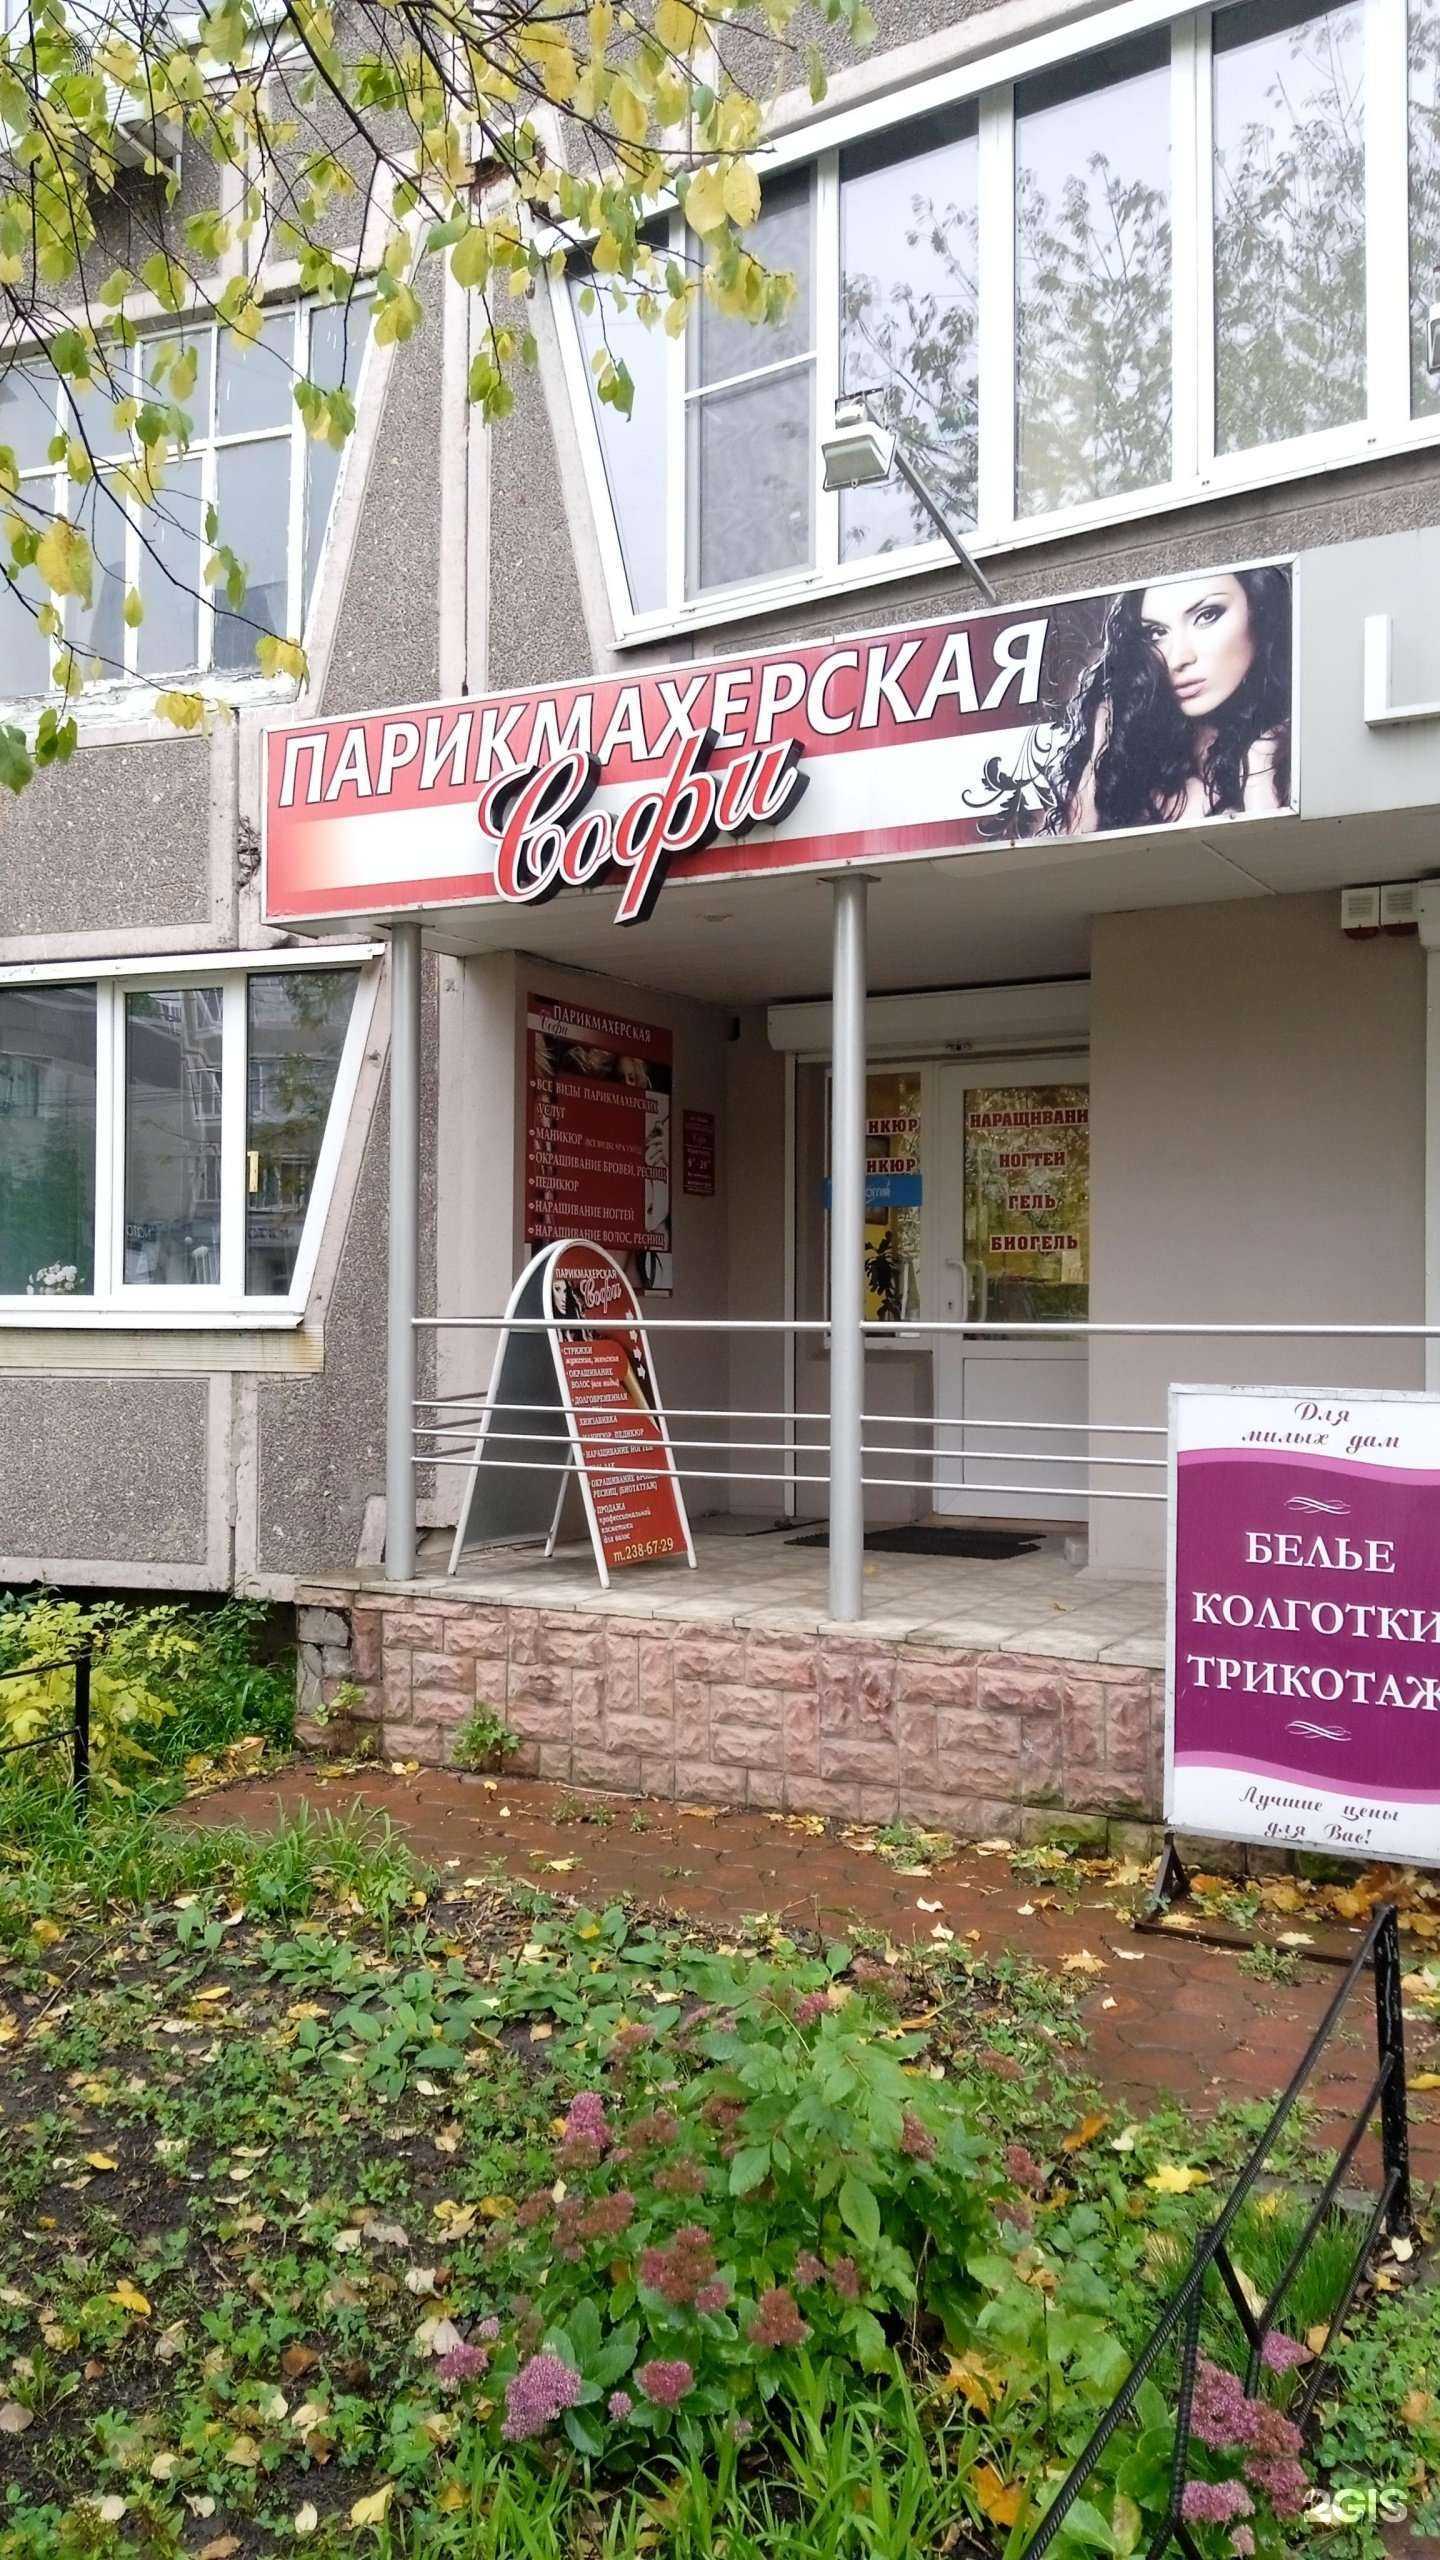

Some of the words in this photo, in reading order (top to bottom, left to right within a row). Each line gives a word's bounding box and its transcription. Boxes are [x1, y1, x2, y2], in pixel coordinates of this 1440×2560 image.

[278, 617, 1050, 809] ПАРИКМАХЕРСКАЯ
[477, 728, 806, 926] Софи
[553, 1004, 651, 1042] ПАРИКМАХЕРСКАЯ
[536, 1078, 553, 1093] ВСЕ
[866, 1117, 918, 1134] ИКЮР
[969, 1108, 1089, 1129] НАРАЩИВАНИ
[535, 1127, 583, 1145] МАНИКЮР
[535, 1152, 601, 1172] ОКРАШИВАНИЕ
[866, 1158, 917, 1173] ИКЮР
[535, 1176, 580, 1193] ПЕДИКЮР
[1008, 1194, 1057, 1211] ГЕЛЬ
[990, 1235, 1079, 1252] БИОГЕЛЬ
[555, 1268, 618, 1280] ПАРИКМАХЕРСКАЯ
[1294, 1401, 1351, 1426] Для
[1241, 1429, 1330, 1445] милых
[1345, 1432, 1400, 1454] дам
[1245, 1531, 1397, 1574] БЕЛЬЕ
[1192, 1591, 1440, 1643] КОЛГОТКИ
[1187, 1654, 1440, 1711] ТРИКОТАЖ
[1239, 1786, 1324, 1812] Лучшие
[1342, 1804, 1400, 1822] цены
[1263, 1821, 1306, 1840] для
[1324, 1824, 1372, 1845] Вас!
